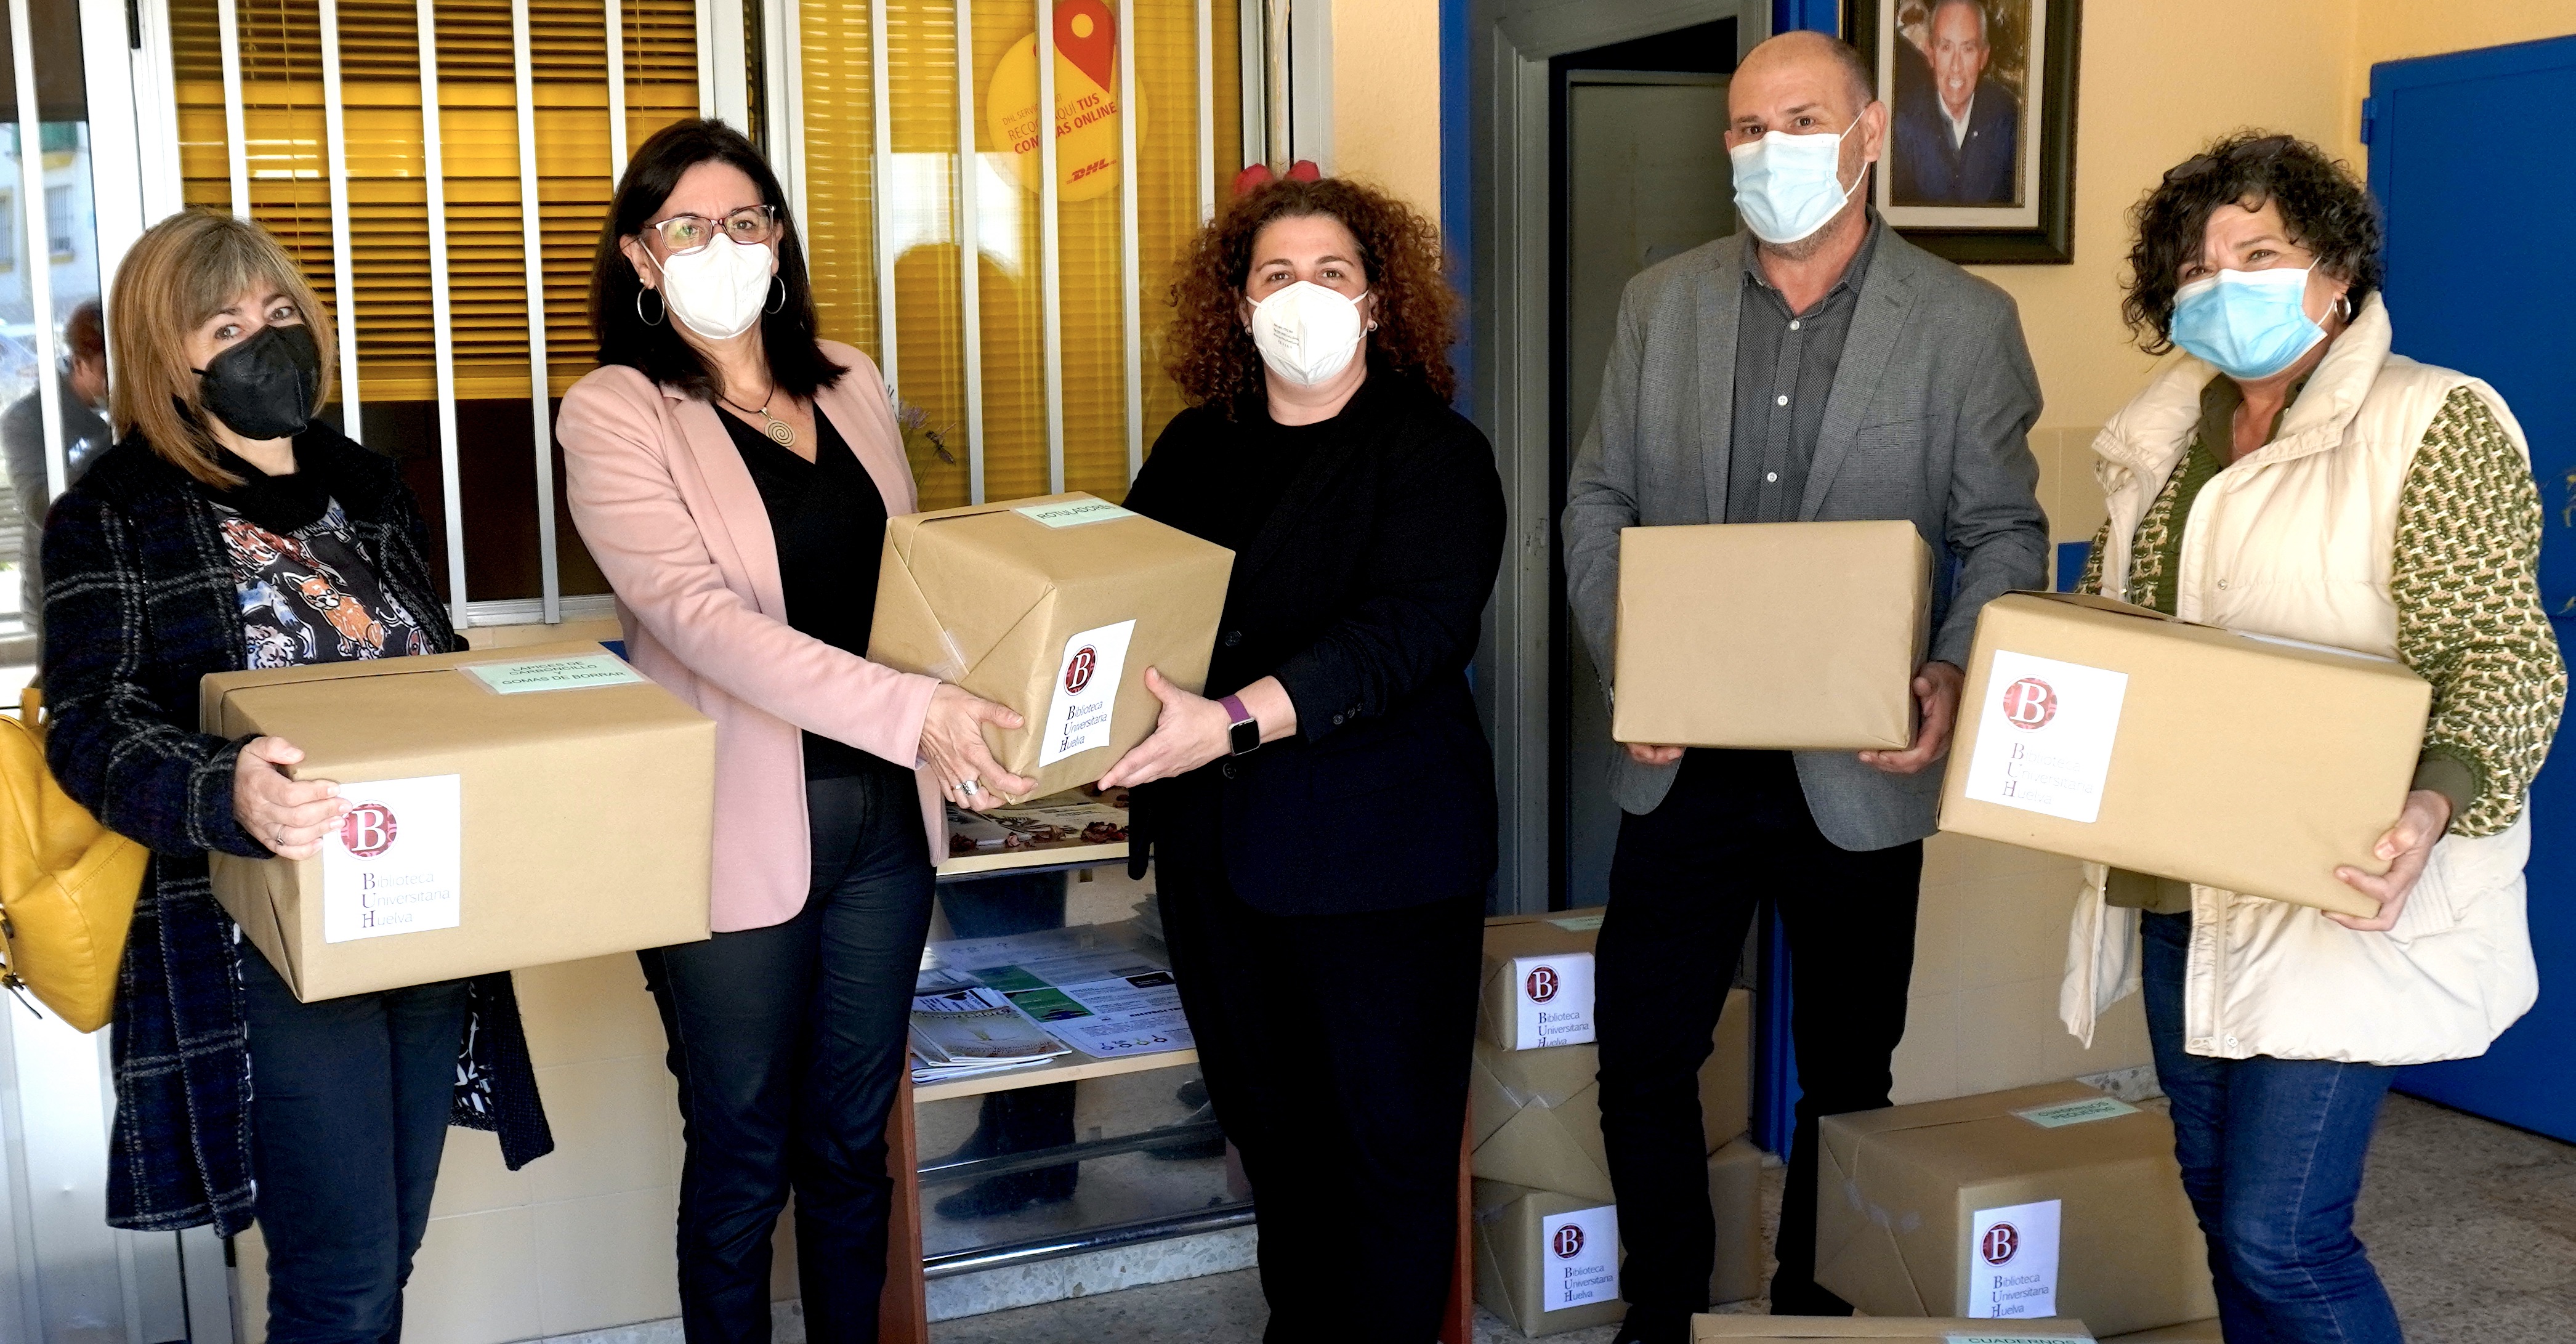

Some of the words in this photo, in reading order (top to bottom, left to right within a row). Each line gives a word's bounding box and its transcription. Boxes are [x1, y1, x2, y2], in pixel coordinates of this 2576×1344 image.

[1077, 93, 1100, 110] TUS
[1003, 116, 1017, 125] DHL
[1074, 102, 1117, 128] ONLINE
[1070, 158, 1110, 182] DHL
[502, 676, 549, 685] GOMAS
[572, 671, 626, 679] BORRAR
[509, 665, 597, 676] CARBONCILLO
[1068, 652, 1091, 689] B
[1067, 701, 1103, 721] Biblioteca
[2009, 681, 2048, 724] B
[1064, 712, 1107, 736] Universitaria
[1059, 735, 1084, 753] Huelva
[2011, 743, 2080, 771] Biblioteca
[2002, 780, 2052, 805] Huelva
[351, 809, 386, 851] B
[363, 872, 434, 890] Biblioteca
[361, 910, 413, 928] Huelva
[1532, 971, 1552, 999] B
[1538, 1011, 1580, 1024] Biblioteca
[1539, 1022, 1589, 1037] Universitaria
[1538, 1037, 1567, 1048] Huelva
[1559, 1229, 1578, 1255] B
[1989, 1228, 2011, 1261] B
[1565, 1266, 1604, 1278] Biblioteca
[1564, 1275, 1613, 1290] Universitaria
[1993, 1274, 2040, 1289] Biblioteca
[1564, 1290, 1593, 1302] Huelva
[1993, 1285, 2049, 1303] Universitaria
[1991, 1304, 2024, 1318] Huelva
